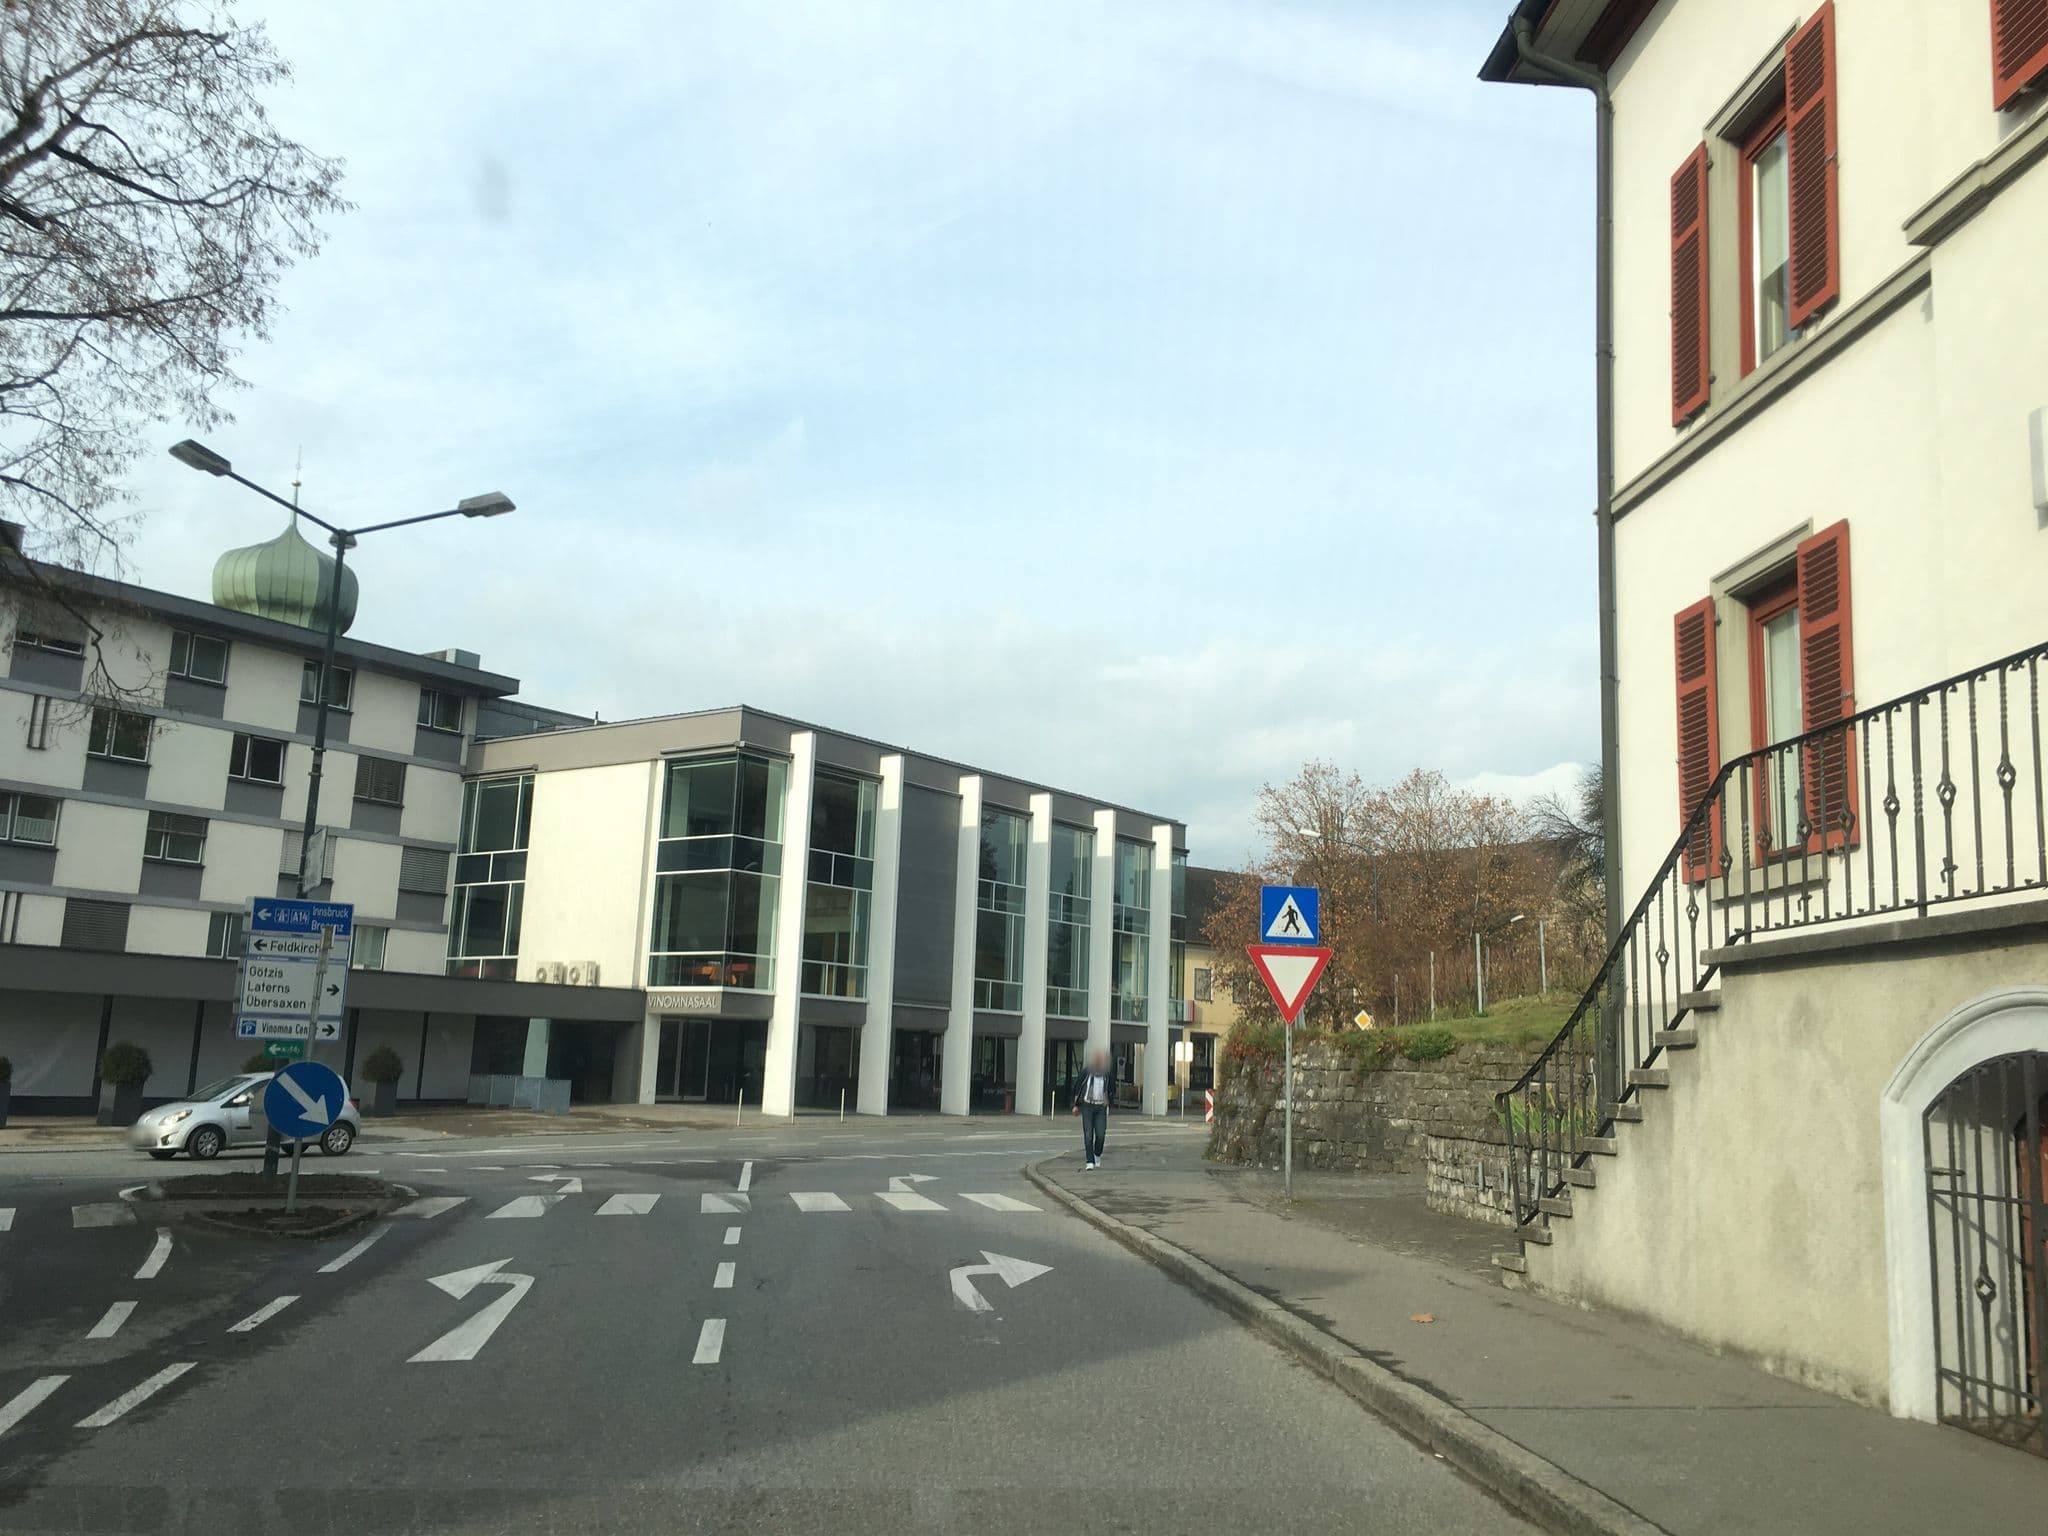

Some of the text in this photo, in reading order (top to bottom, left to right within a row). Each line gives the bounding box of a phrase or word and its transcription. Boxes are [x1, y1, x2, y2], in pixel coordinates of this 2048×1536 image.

[292, 911, 308, 923] A14
[312, 905, 349, 919] Innsbruck
[249, 966, 284, 978] Götzis
[247, 981, 290, 994] Laterns
[246, 995, 307, 1009] Übersaxen
[648, 995, 718, 1009] VINOMNASAAL
[261, 1023, 293, 1034] Vinomna
